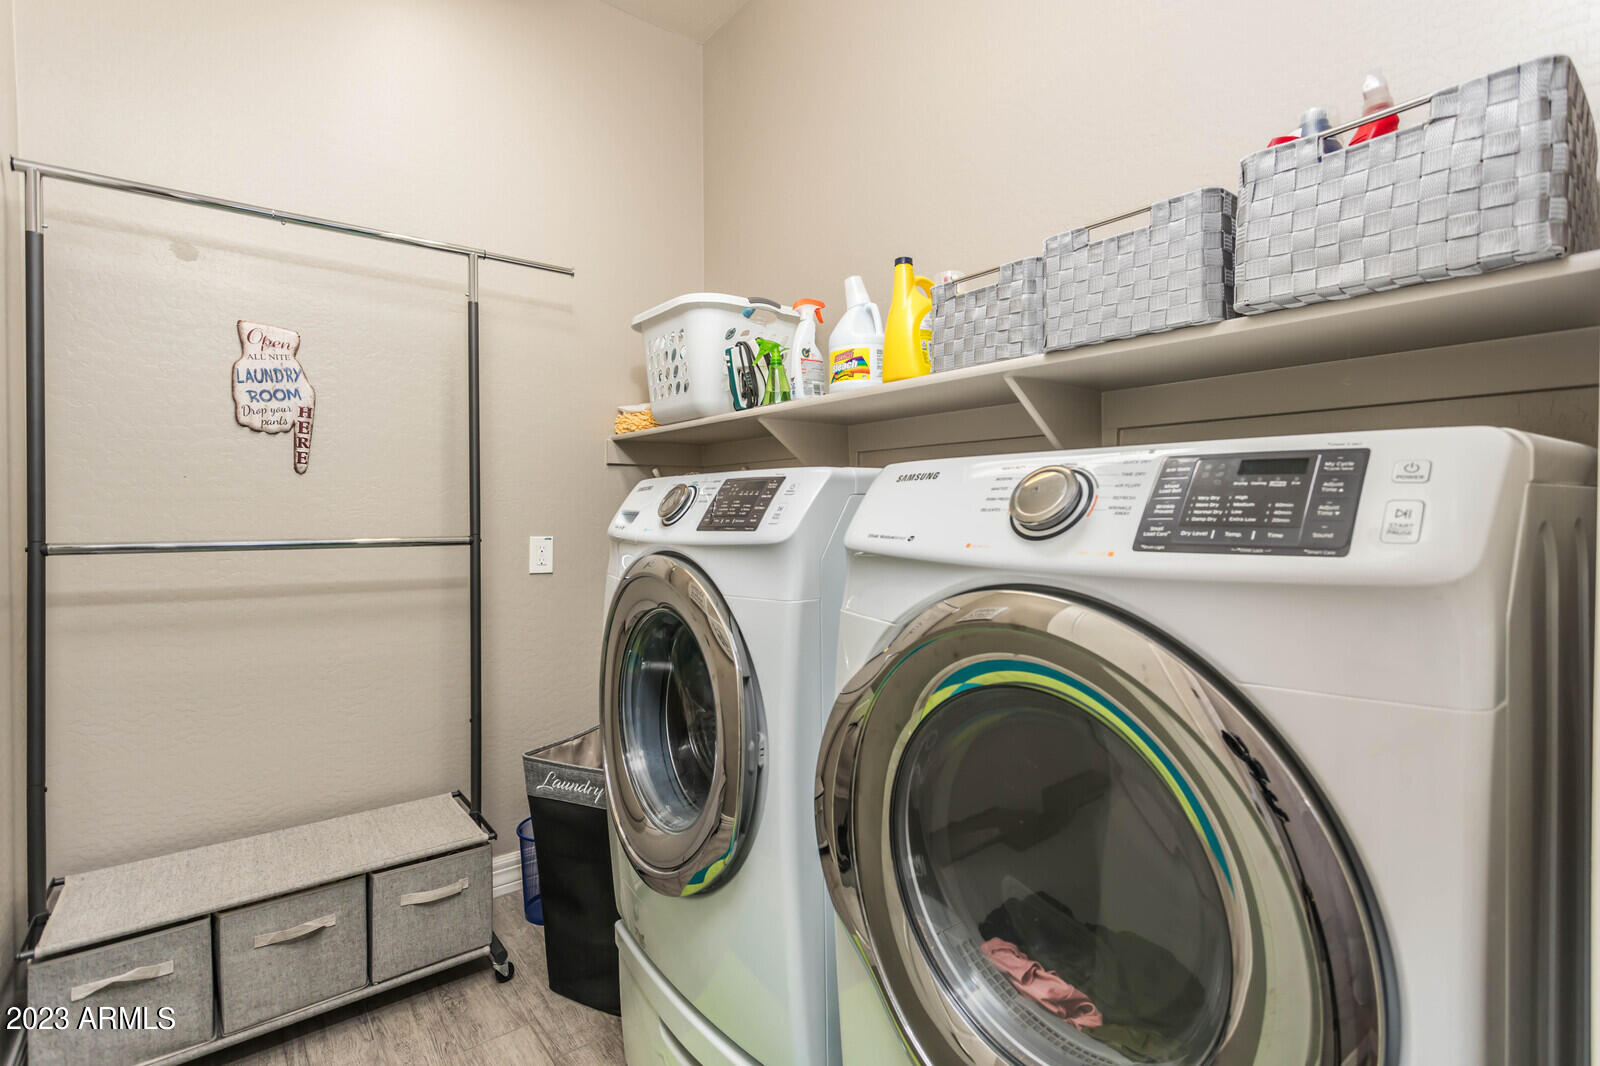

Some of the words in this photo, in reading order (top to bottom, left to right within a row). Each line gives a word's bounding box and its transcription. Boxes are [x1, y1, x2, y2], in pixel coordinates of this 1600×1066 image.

[247, 327, 293, 351] Open
[247, 353, 266, 361] ALL
[268, 353, 291, 361] NITE
[236, 367, 301, 384] LAUNDRY
[246, 388, 302, 403] ROOM
[241, 404, 267, 418] Drop
[270, 405, 293, 418] your
[260, 416, 288, 429] pants
[297, 406, 312, 465] HERE
[896, 471, 941, 483] SAMSUNG
[536, 771, 604, 804] Laundry
